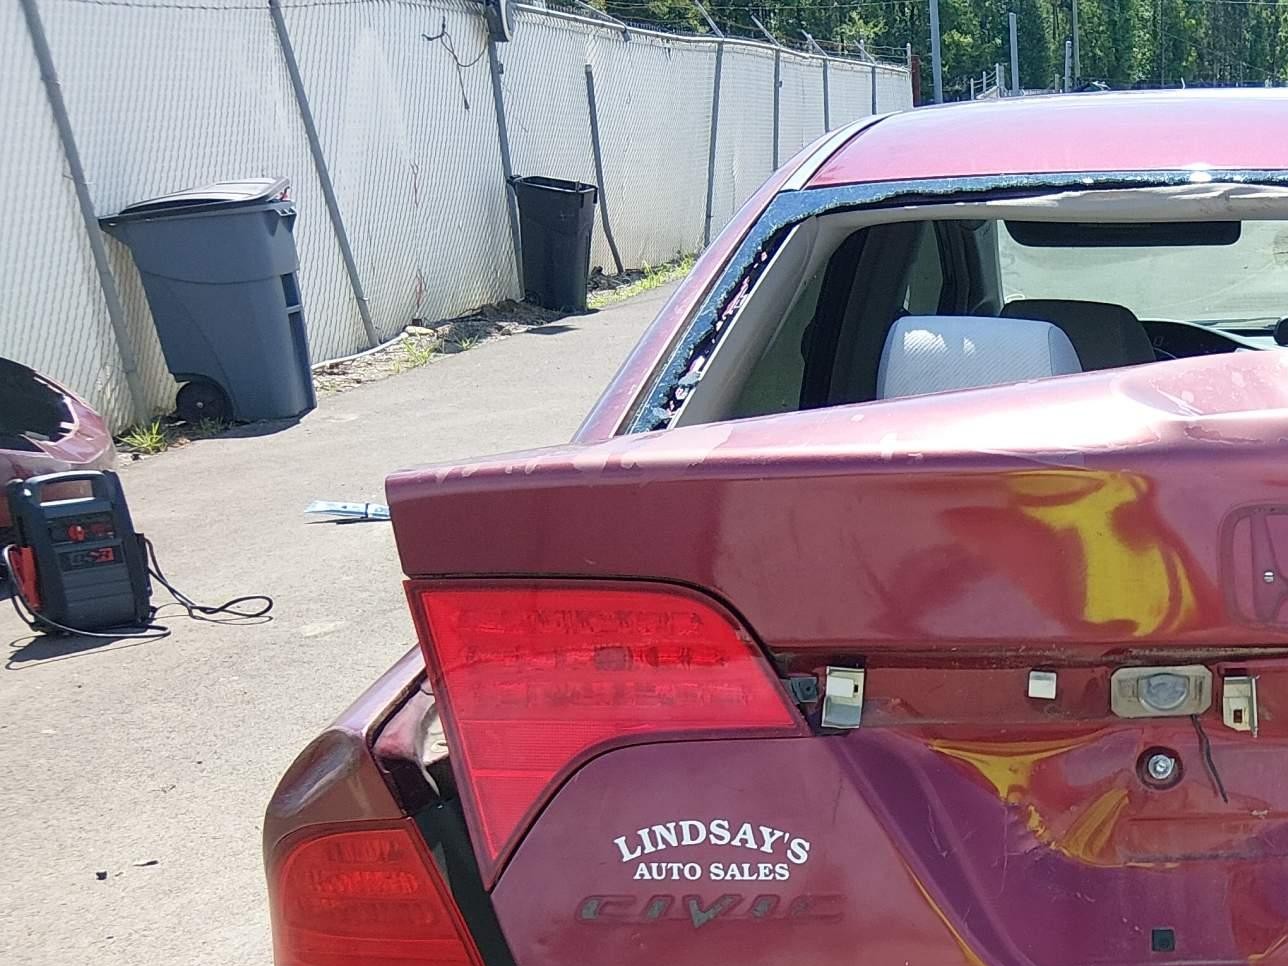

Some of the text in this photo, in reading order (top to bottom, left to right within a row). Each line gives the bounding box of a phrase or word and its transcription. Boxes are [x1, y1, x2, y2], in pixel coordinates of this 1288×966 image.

[613, 819, 811, 865] LINDSAY'S
[633, 862, 790, 881] AUTO SALES
